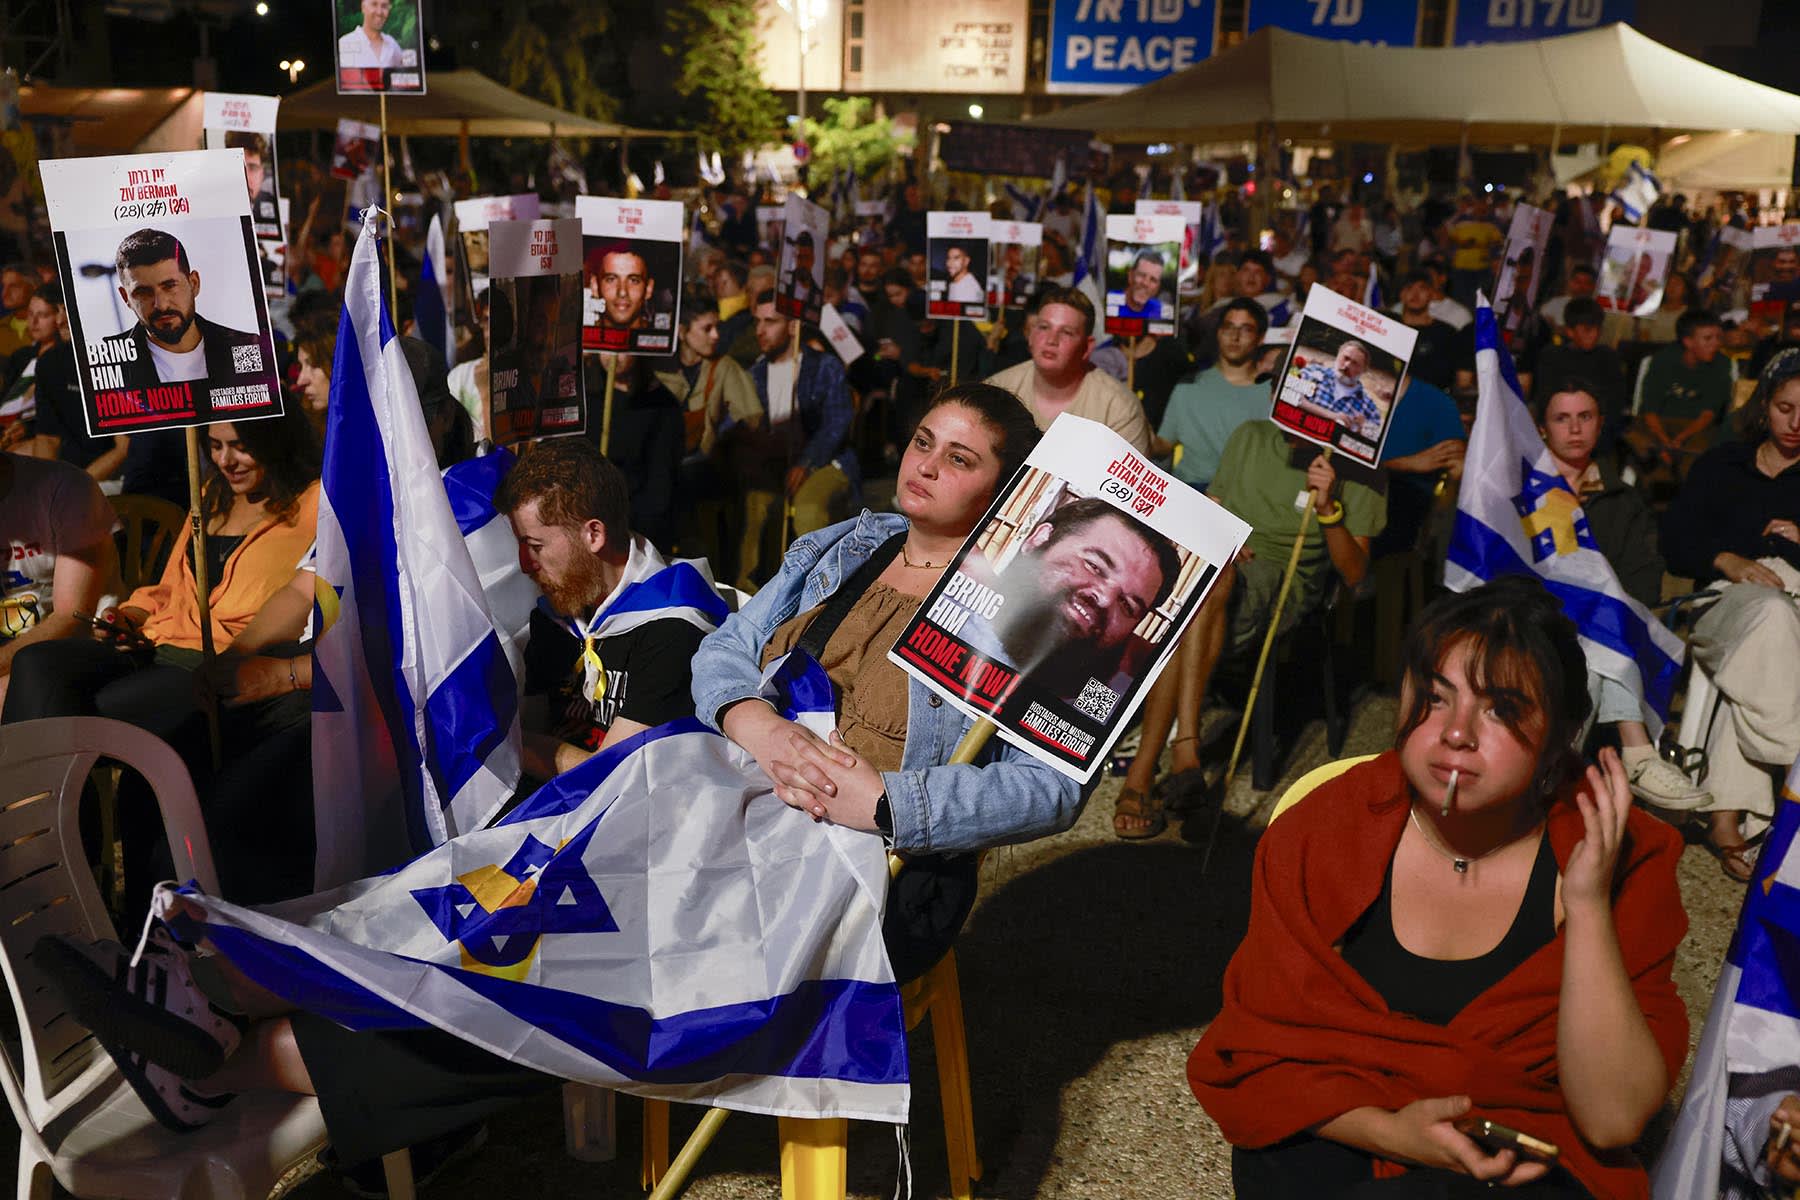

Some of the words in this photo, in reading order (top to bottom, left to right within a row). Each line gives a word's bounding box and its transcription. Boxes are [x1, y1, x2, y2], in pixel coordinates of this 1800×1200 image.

[1065, 35, 1198, 72] PEACE
[128, 169, 150, 186] ברמן
[152, 168, 165, 182] זיו
[120, 187, 135, 202] ZIV
[137, 184, 178, 200] BERMAN
[87, 338, 138, 366] BRING
[90, 364, 125, 391] HIM
[210, 386, 235, 397] HOSTAGES
[235, 385, 246, 394] AND
[246, 384, 268, 393] MISSING
[494, 368, 518, 393] BRING
[95, 389, 145, 418] HOME
[146, 382, 194, 411] NOW!
[211, 394, 244, 408] FAMILIES
[244, 391, 271, 404] FORUM
[1121, 451, 1145, 476] הורן
[1100, 477, 1133, 502] (38)
[1107, 460, 1139, 487] EITAN
[1135, 481, 1167, 507] HORN
[1142, 469, 1169, 493] איתן
[943, 569, 1006, 620] BRING
[926, 593, 971, 636] HIM
[907, 621, 968, 673] HOME
[958, 654, 1021, 704] NOW!
[1021, 709, 1061, 741] FAMILIES
[1057, 732, 1091, 758] FORUM
[1029, 700, 1060, 725] HOSTAGES
[1056, 718, 1071, 732] AND
[1067, 725, 1096, 746] MISSING
